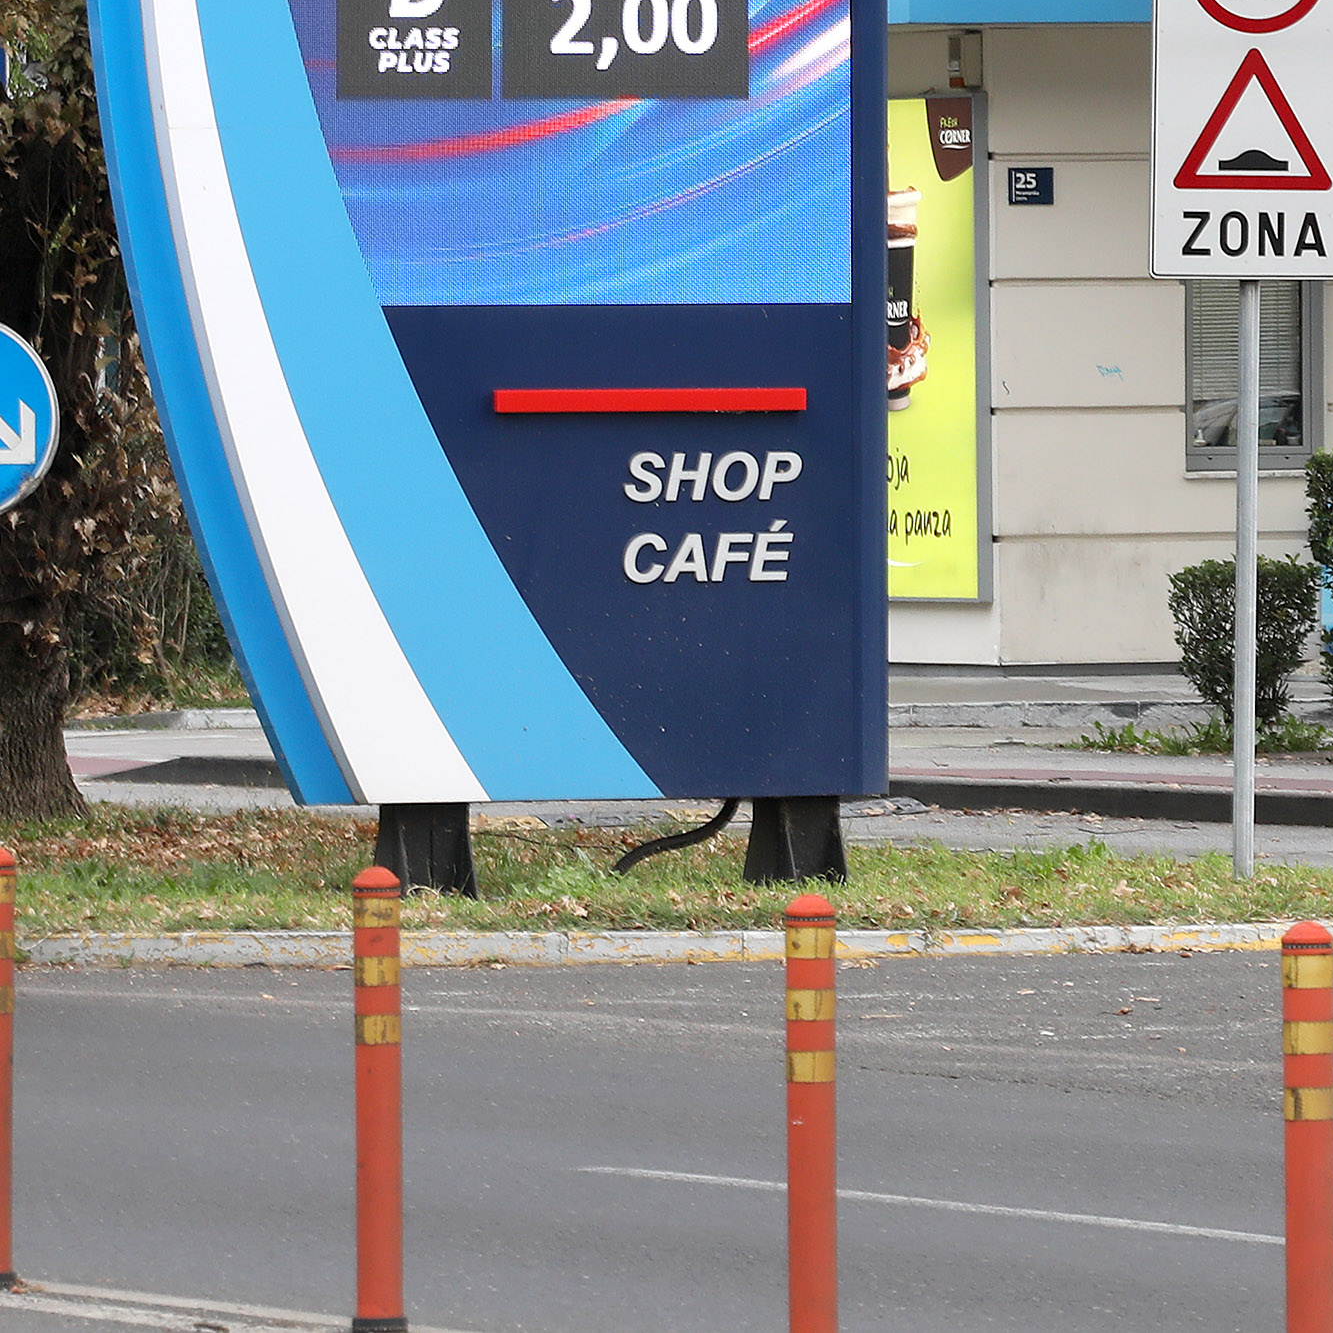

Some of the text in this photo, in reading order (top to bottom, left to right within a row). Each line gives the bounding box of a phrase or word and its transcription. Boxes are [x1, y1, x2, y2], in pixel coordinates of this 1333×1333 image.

[368, 27, 460, 50] CLASS
[378, 50, 450, 73] PLUS
[1015, 173, 1037, 189] 25
[1181, 210, 1328, 258] ZONA
[623, 451, 803, 503] SHOP
[623, 519, 795, 584] CAFÉ
